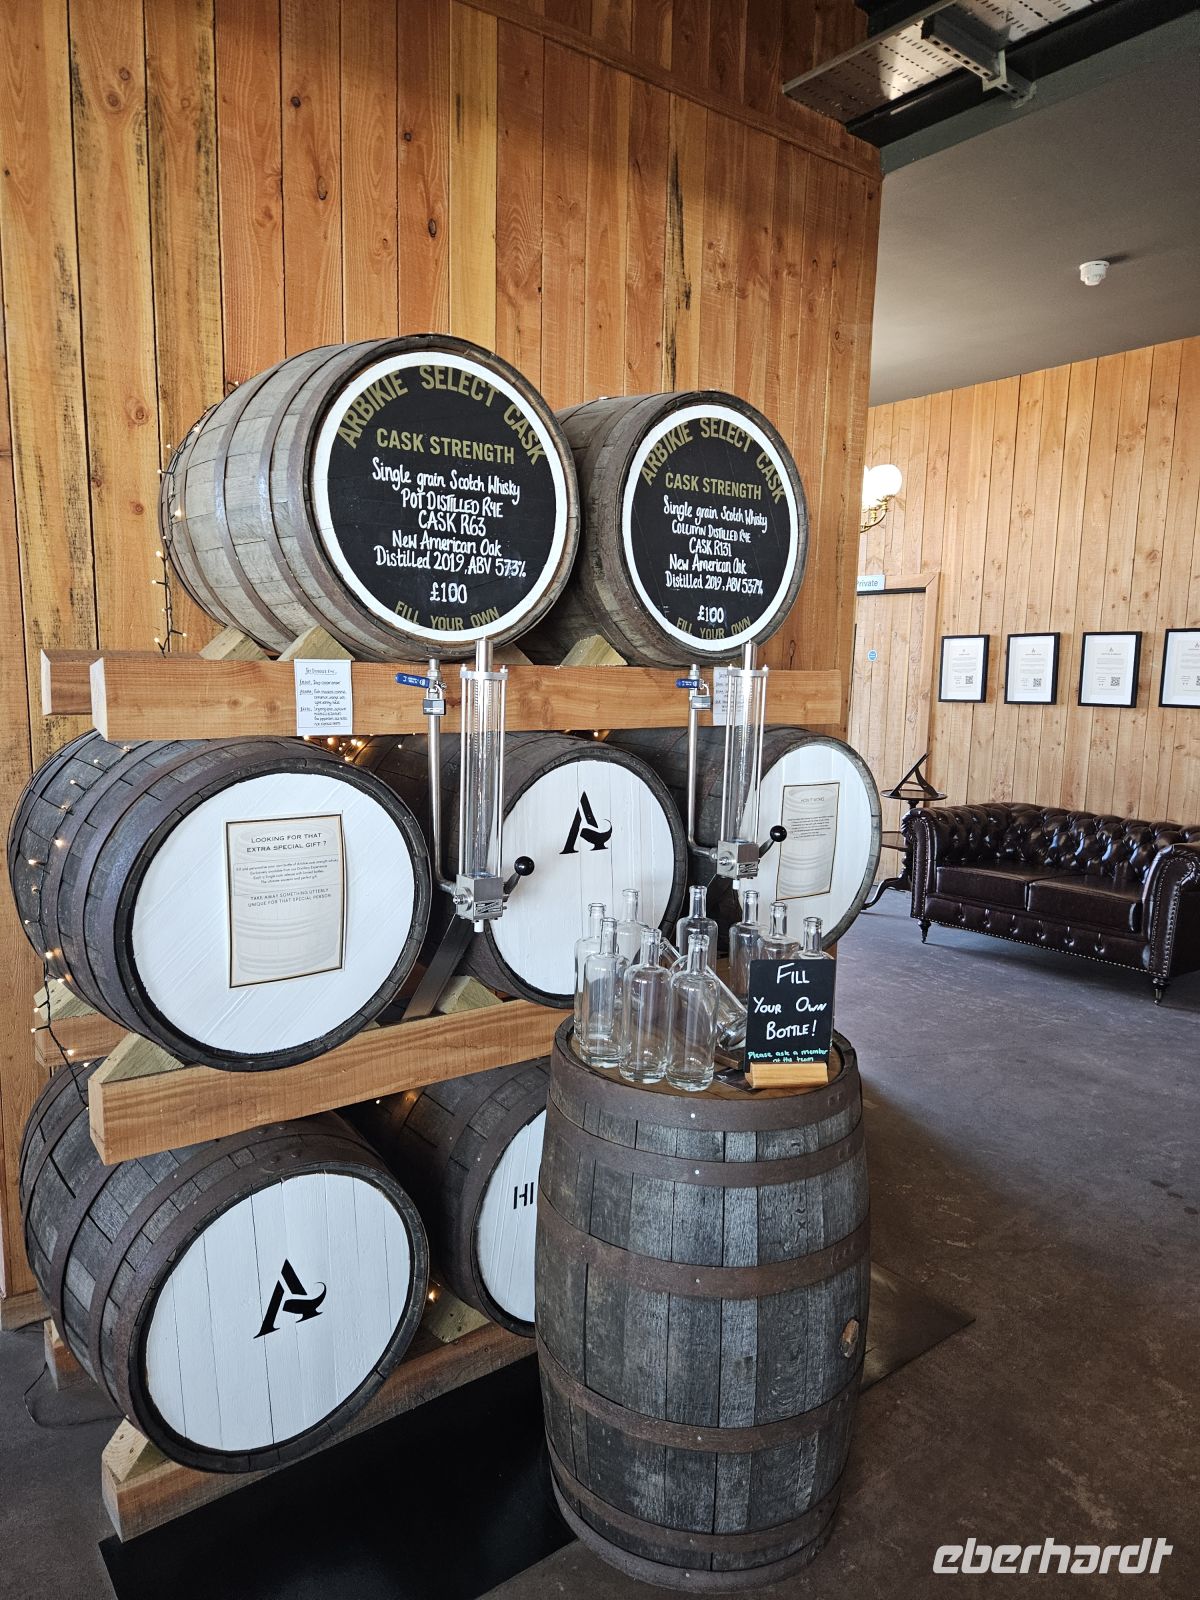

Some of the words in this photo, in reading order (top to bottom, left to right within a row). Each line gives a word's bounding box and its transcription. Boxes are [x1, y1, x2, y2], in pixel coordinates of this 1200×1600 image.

[338, 369, 408, 449] ARBIKIE
[419, 364, 500, 407] SELECT
[503, 404, 546, 466] CASK
[376, 427, 425, 453] CASK
[429, 435, 515, 465] STRENGTH
[640, 421, 693, 487] ARBIKIE
[700, 417, 754, 453] SELECT
[755, 451, 786, 505] CASK
[371, 456, 412, 491] Single
[416, 472, 447, 493] grain
[449, 469, 486, 492] Scotch
[487, 475, 521, 505] Whisky
[665, 472, 700, 492] CASK
[702, 477, 762, 500] STRENGTH
[481, 496, 505, 518] RYE
[663, 494, 693, 522] Single
[694, 506, 718, 526] grain
[720, 505, 744, 523] Scotch
[744, 508, 768, 534] Whisky
[418, 509, 457, 533] CASK
[460, 515, 487, 537] R63
[392, 529, 418, 550] New
[420, 529, 477, 555] American
[480, 538, 503, 557] Oak
[688, 536, 713, 556] CASK
[713, 539, 732, 557] R131
[373, 545, 432, 570] Distilled
[669, 553, 689, 571] New
[691, 553, 732, 574] American
[732, 557, 748, 575] Oak
[664, 570, 704, 589] Distilled
[429, 581, 468, 604] £100
[394, 600, 421, 626] FILL
[430, 615, 464, 631] YOUR
[470, 606, 501, 628] OWN
[696, 604, 725, 623] £100
[676, 616, 693, 636] FILL
[700, 627, 725, 640] YOUR
[730, 615, 751, 636] OWN
[246, 845, 271, 853] EXTRA
[273, 843, 304, 851] SPECIAL
[251, 835, 285, 844] LOOKING
[776, 962, 811, 984] FILL
[752, 996, 782, 1015] YOUR
[795, 996, 827, 1012] OWN
[747, 1051, 773, 1060] Please
[801, 1047, 829, 1056] member
